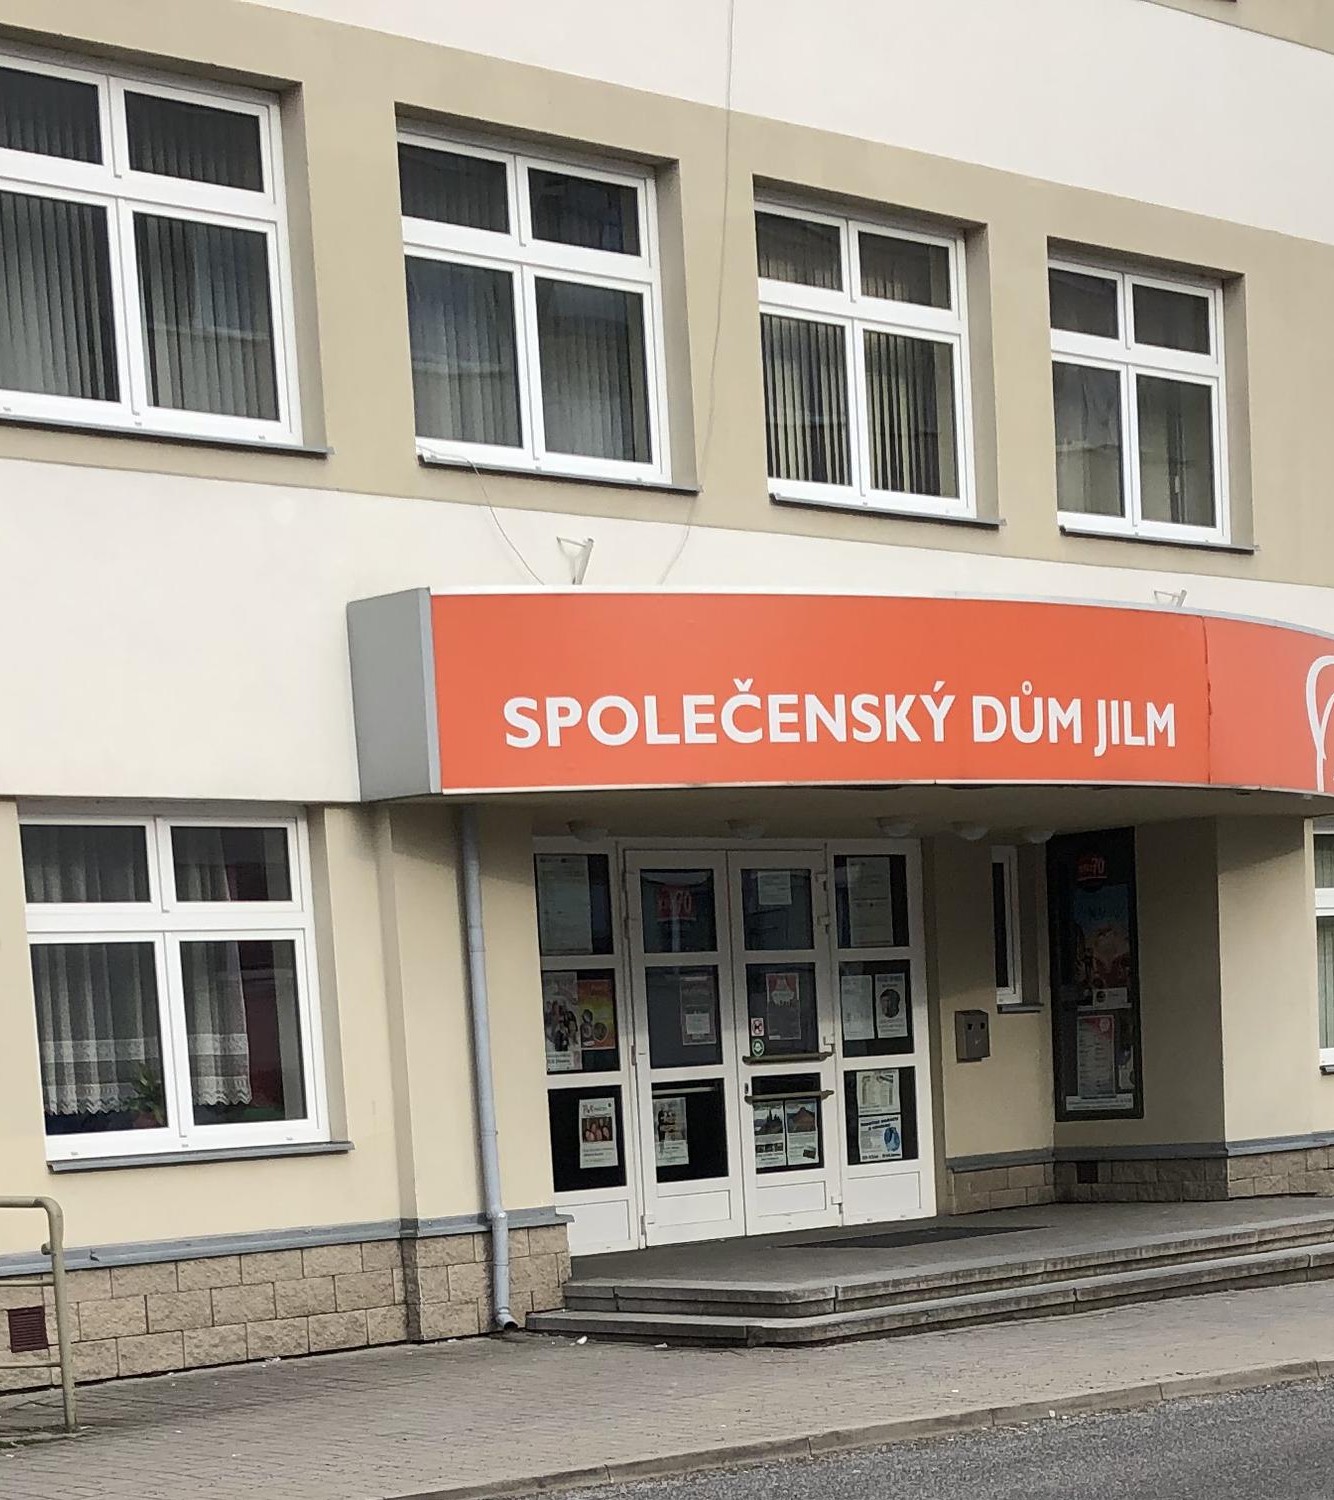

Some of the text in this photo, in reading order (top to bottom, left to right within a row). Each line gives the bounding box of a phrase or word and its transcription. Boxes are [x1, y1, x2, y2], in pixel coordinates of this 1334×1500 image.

[503, 678, 1176, 757] SPOLEČENSKÝ DŮM JILM
